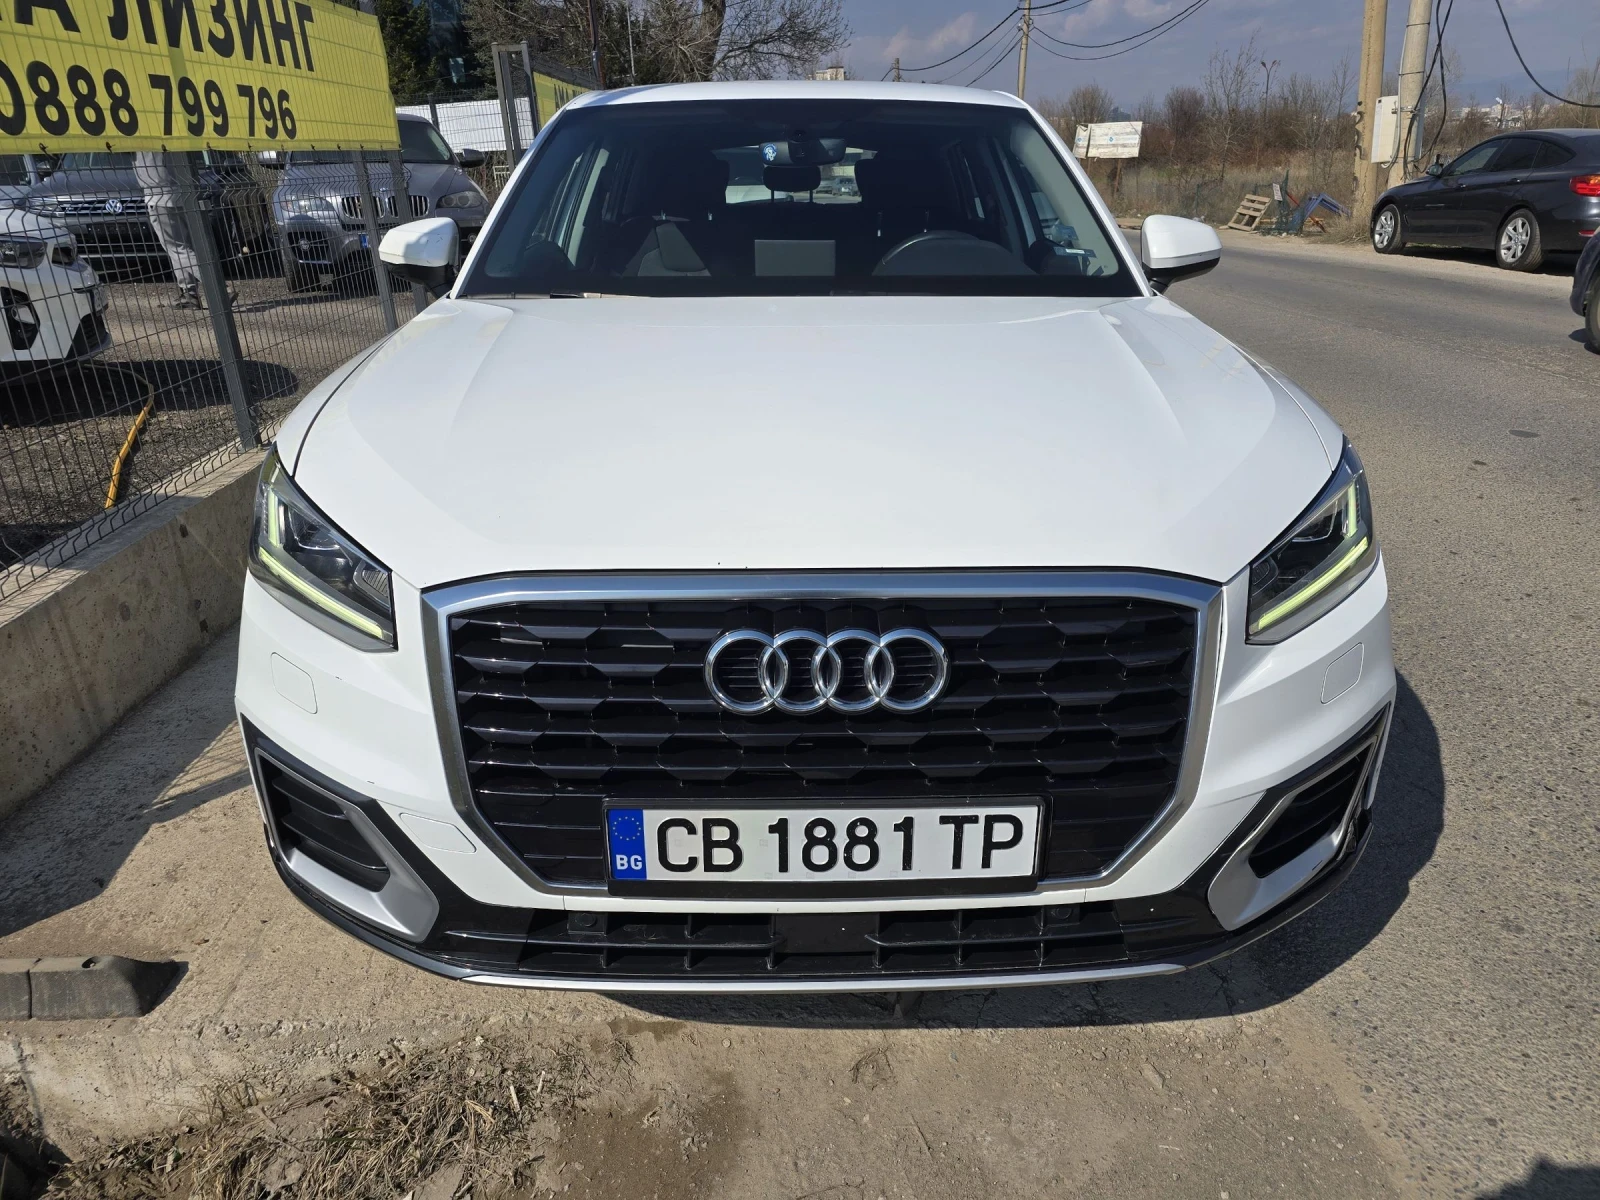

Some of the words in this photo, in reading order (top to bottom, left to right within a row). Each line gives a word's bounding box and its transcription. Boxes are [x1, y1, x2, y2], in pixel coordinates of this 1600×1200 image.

[0, 60, 139, 136] 0888
[148, 74, 229, 137] 799
[236, 84, 297, 140] 796
[615, 854, 643, 870] BG
[657, 817, 743, 873] CB
[768, 816, 914, 873] 1881
[939, 814, 1024, 869] TP
